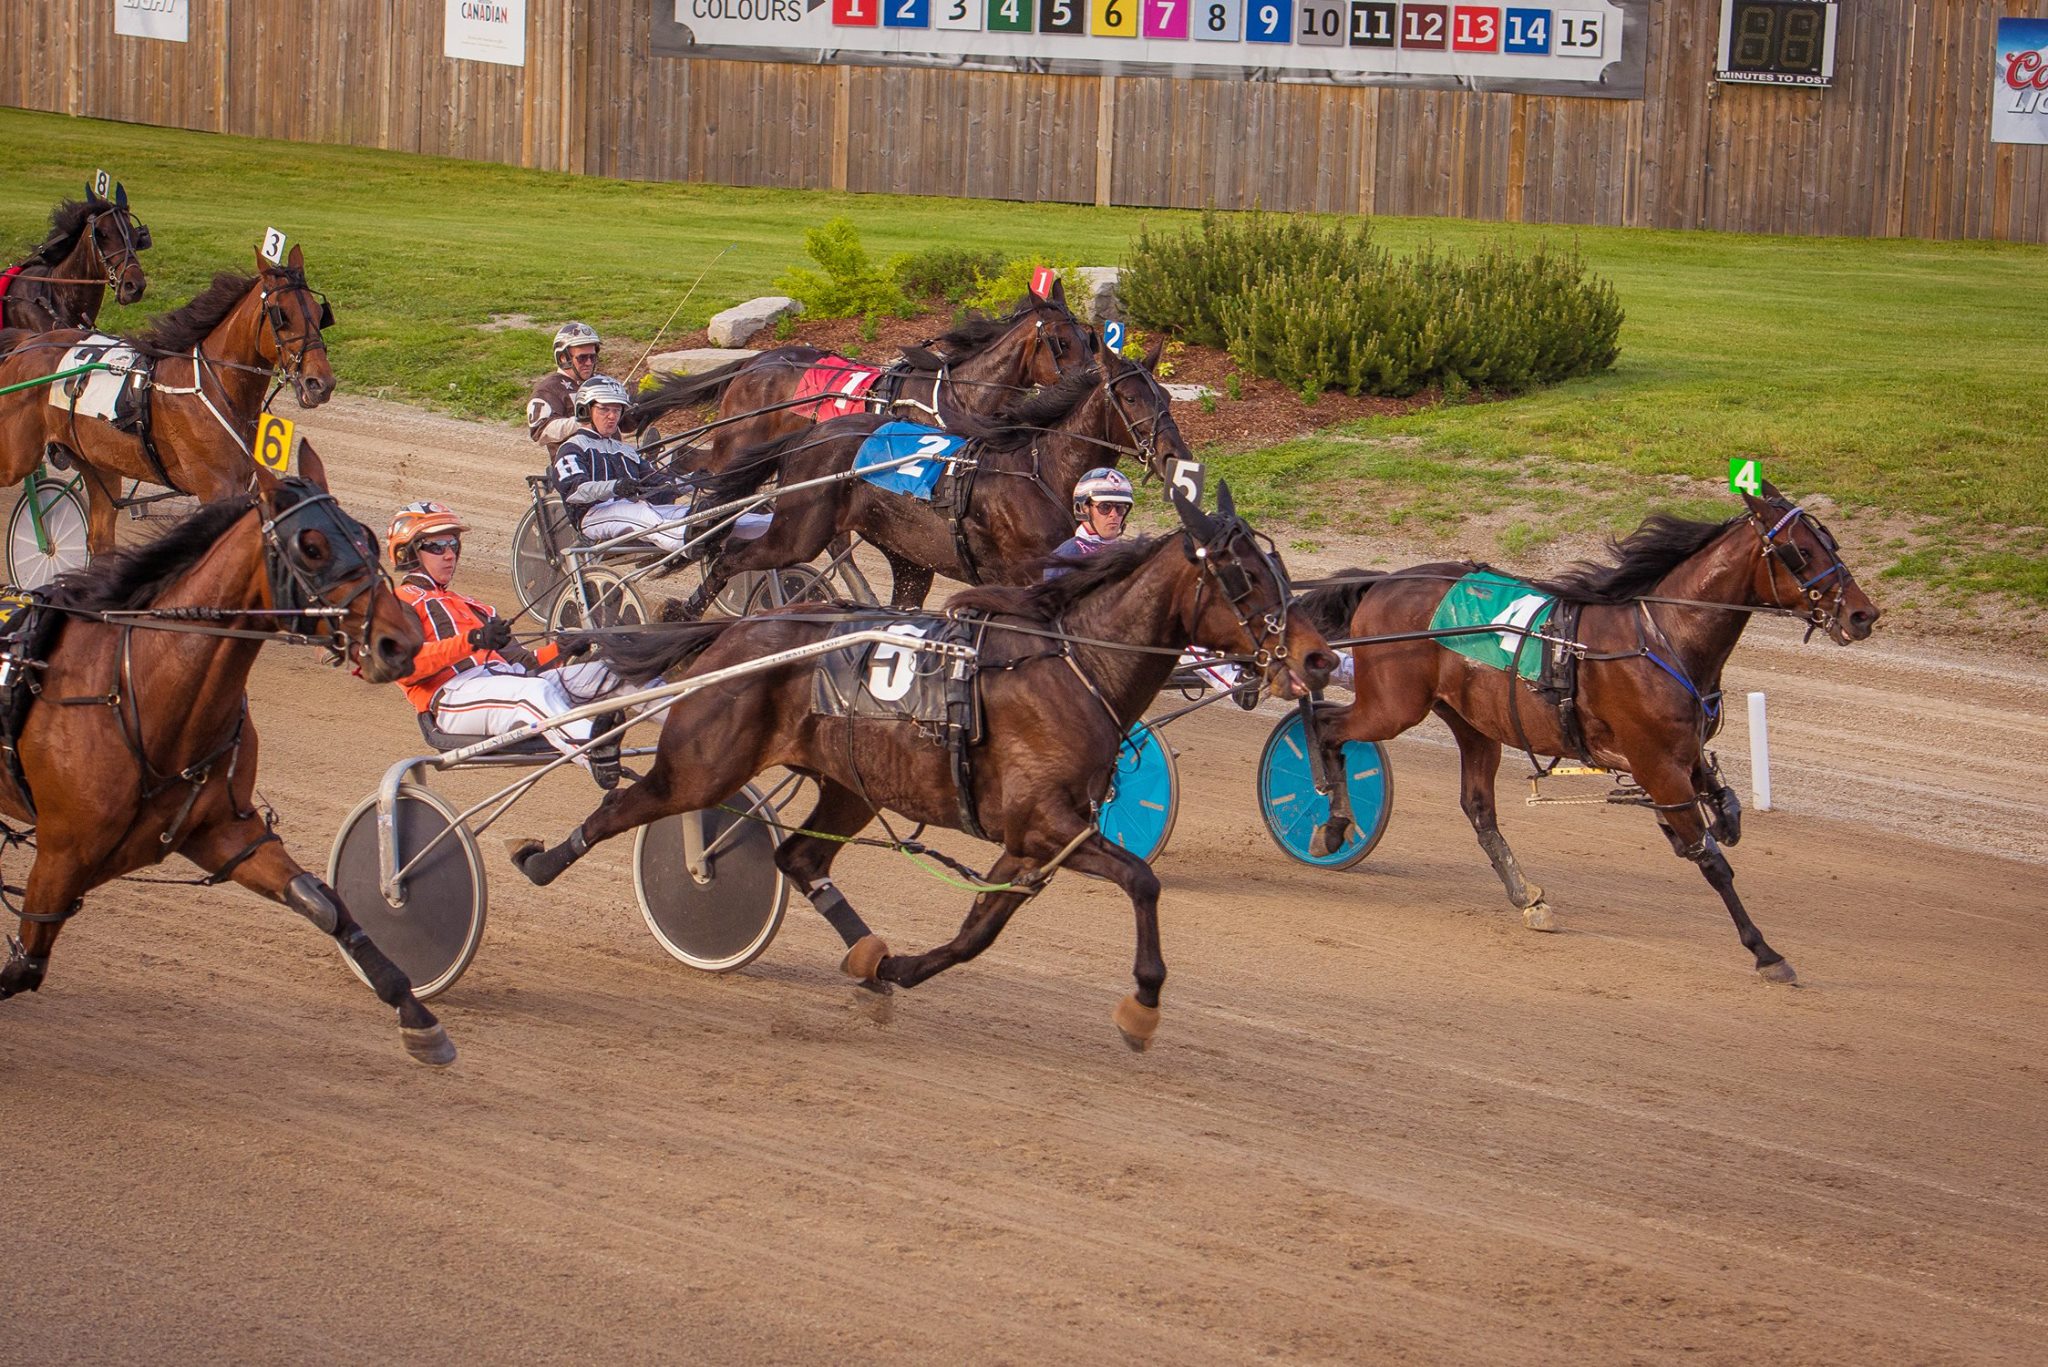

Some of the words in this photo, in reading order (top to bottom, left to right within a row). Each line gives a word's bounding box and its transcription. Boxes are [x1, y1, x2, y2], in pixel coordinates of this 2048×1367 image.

[461, 2, 508, 24] CANADIAN
[693, 0, 801, 22] COLOURS
[846, 0, 864, 17] 1
[896, 0, 916, 19] 2
[948, 0, 968, 21] 3
[1000, 0, 1020, 24] 4
[1051, 0, 1072, 26] 5
[1104, 0, 1123, 28] 6
[1156, 1, 1176, 30] 7
[1207, 4, 1226, 32] 8
[1259, 5, 1279, 35] 9
[1302, 8, 1340, 37] 10
[1353, 9, 1392, 39] 11
[1405, 12, 1444, 42] 12
[1457, 14, 1495, 44] 13
[1508, 16, 1547, 46] 14
[1561, 19, 1599, 48] 15
[1720, 70, 1775, 82] MINUTES
[1777, 74, 1793, 83] TO
[1796, 75, 1830, 84] POST
[97, 172, 107, 196] 8
[266, 233, 280, 257] 3
[1036, 271, 1048, 294] 1
[1106, 322, 1121, 354] 2
[834, 371, 872, 410] 1
[528, 402, 545, 424] J
[262, 418, 286, 466] 6
[897, 435, 951, 478] 2
[554, 454, 585, 481] H
[1170, 460, 1200, 503] 5
[1734, 460, 1759, 496] 4
[868, 624, 928, 702] 5
